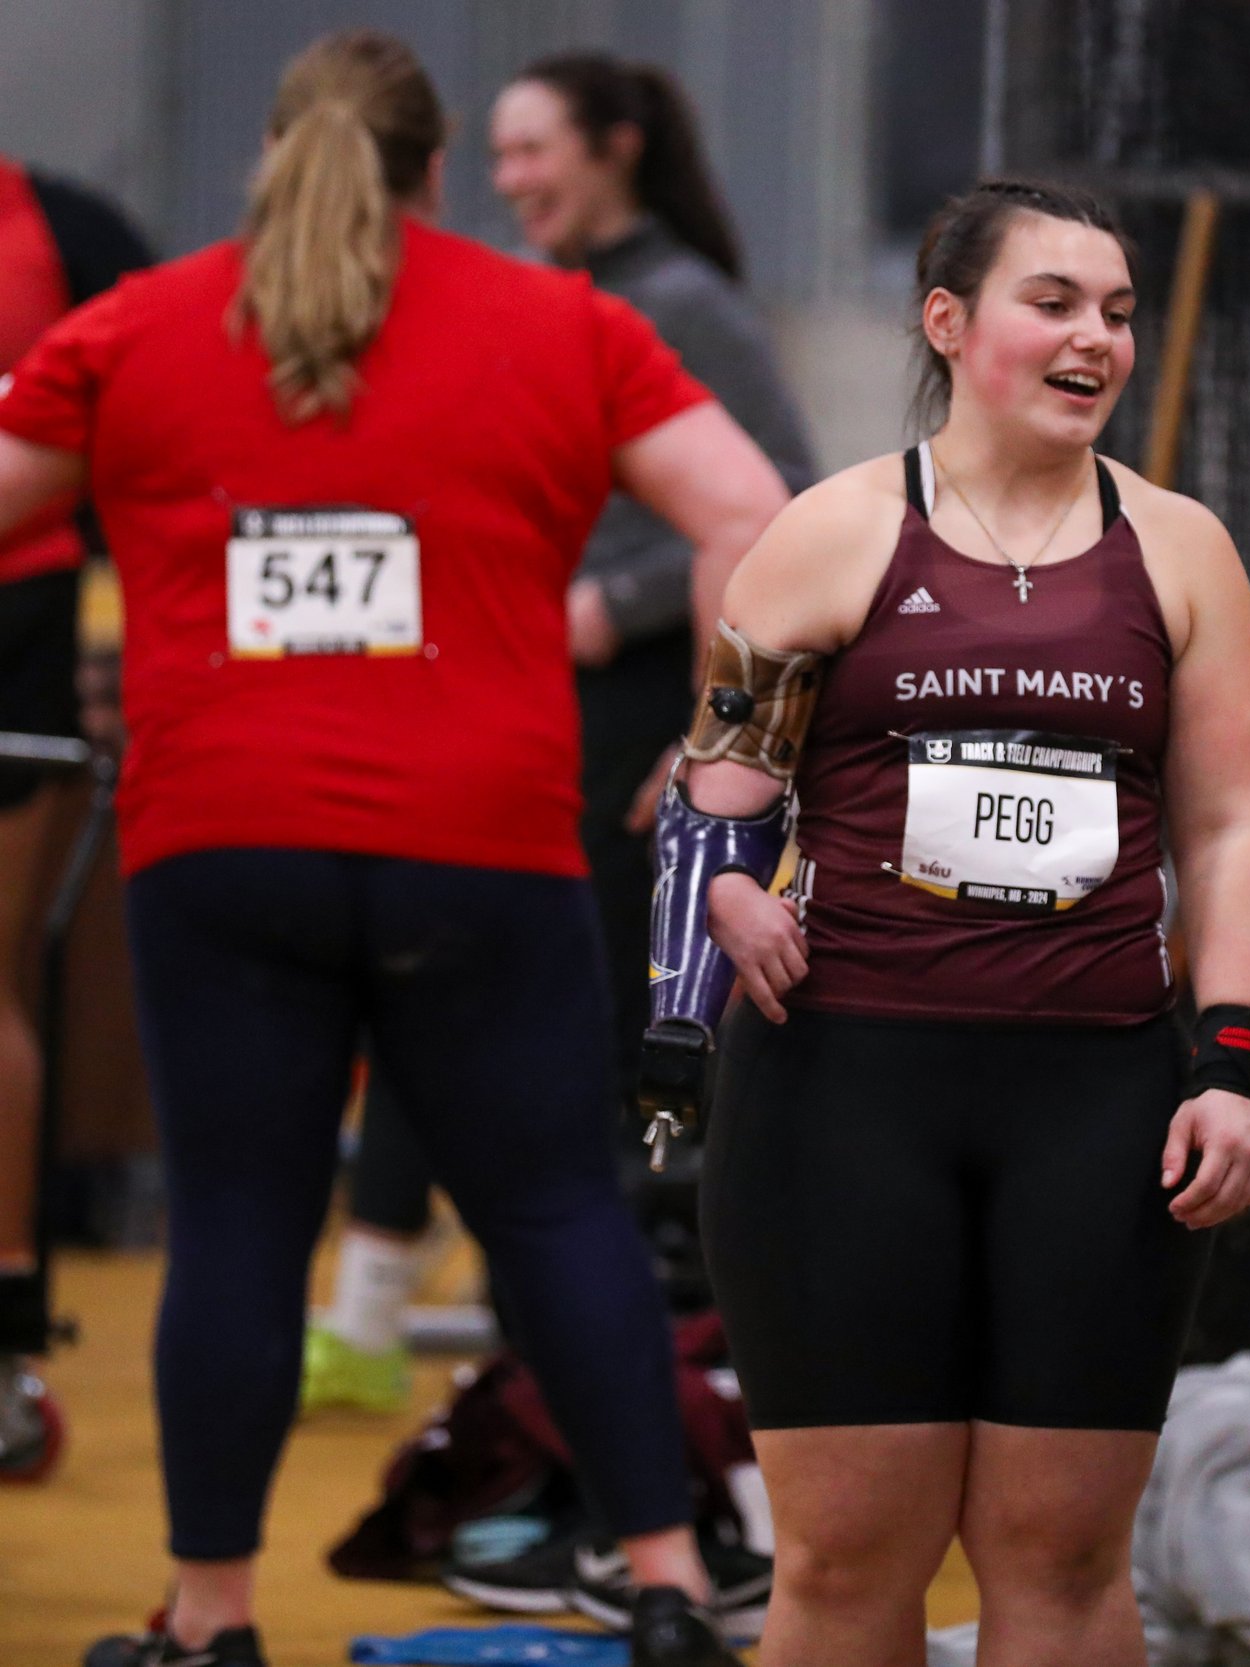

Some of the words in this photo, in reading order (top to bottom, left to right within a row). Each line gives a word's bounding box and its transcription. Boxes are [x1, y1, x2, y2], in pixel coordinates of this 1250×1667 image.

[261, 551, 387, 609] 547
[897, 602, 941, 614] adidas
[894, 668, 1005, 700] SAINT
[1016, 669, 1144, 709] MARY'S
[960, 742, 994, 761] TRACK
[995, 742, 1006, 763] &
[1006, 743, 1031, 765] FIELD
[1032, 747, 1103, 774] CHAMPIONSHIPS
[974, 792, 1055, 845] PEGG
[1027, 891, 1049, 905] 2024
